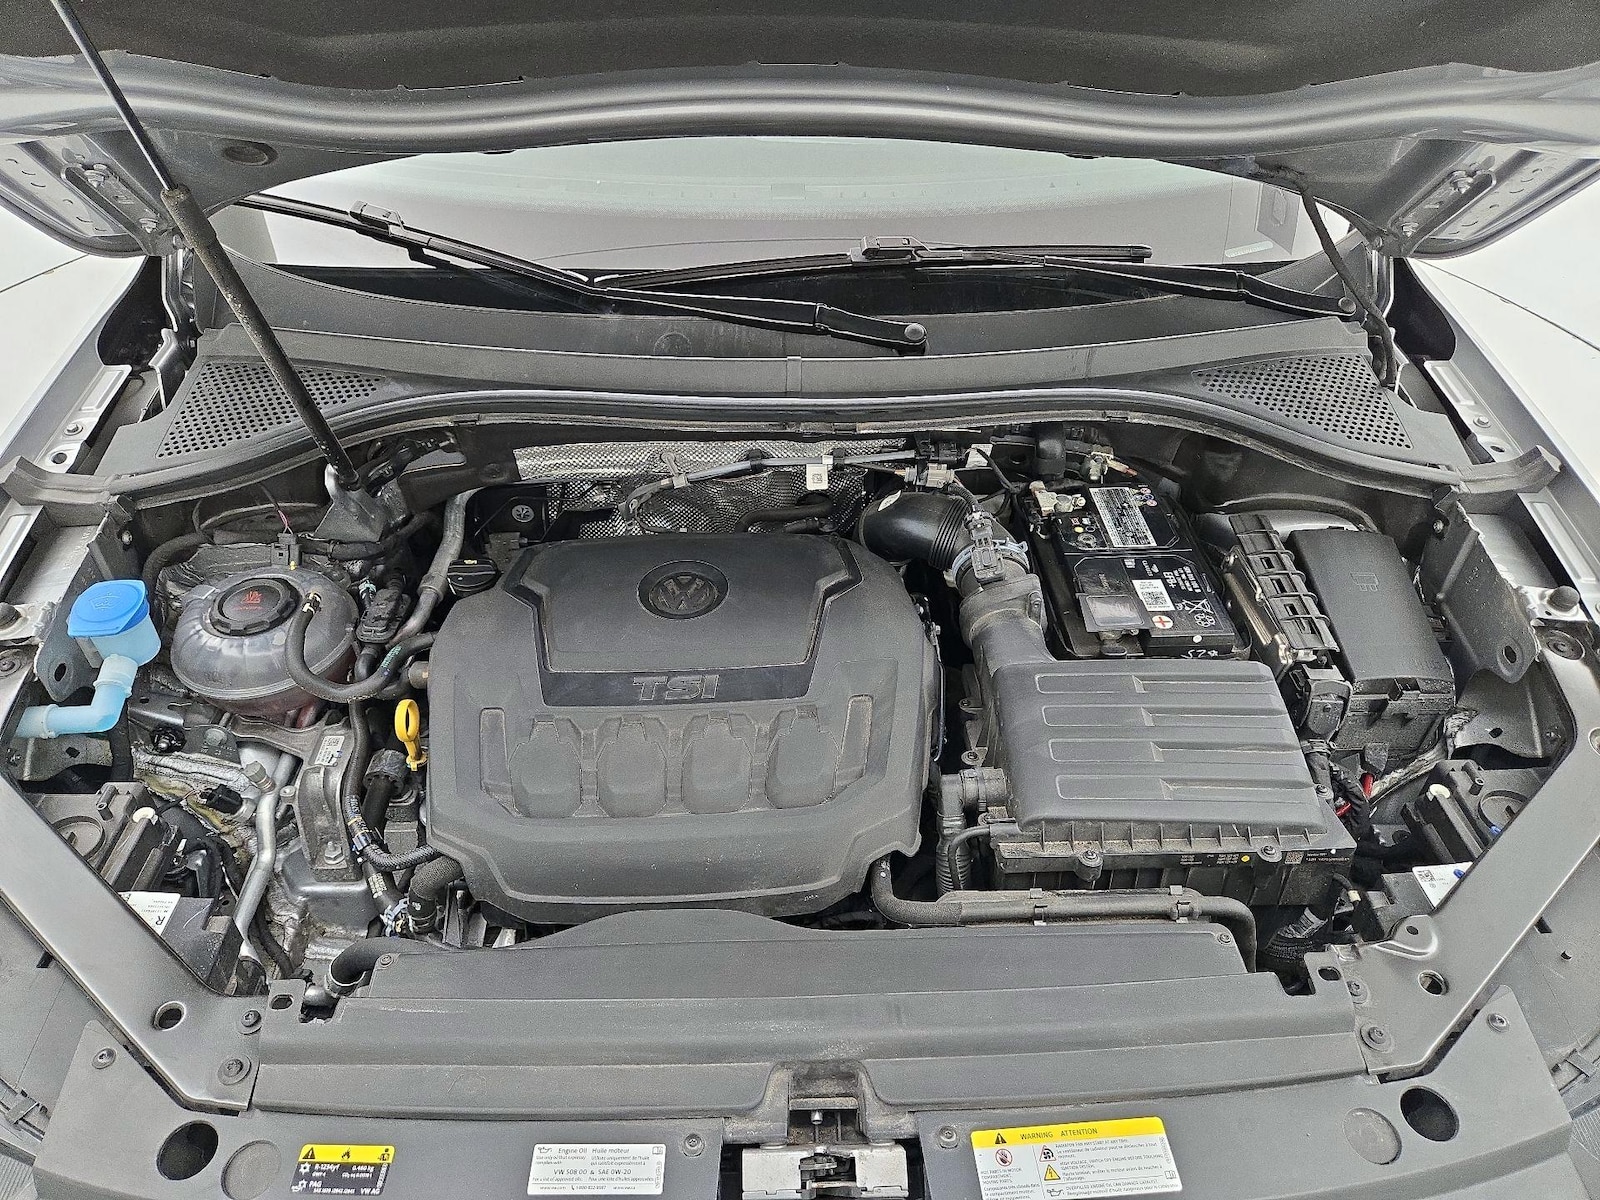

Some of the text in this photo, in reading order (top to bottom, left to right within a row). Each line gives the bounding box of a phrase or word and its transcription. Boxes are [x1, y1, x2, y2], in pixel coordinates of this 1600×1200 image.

[622, 674, 720, 701] TSI
[155, 915, 166, 926] R
[1020, 1128, 1098, 1140] WARNING ATTENTION
[308, 1180, 322, 1189] PAG
[371, 1187, 380, 1195] AG
